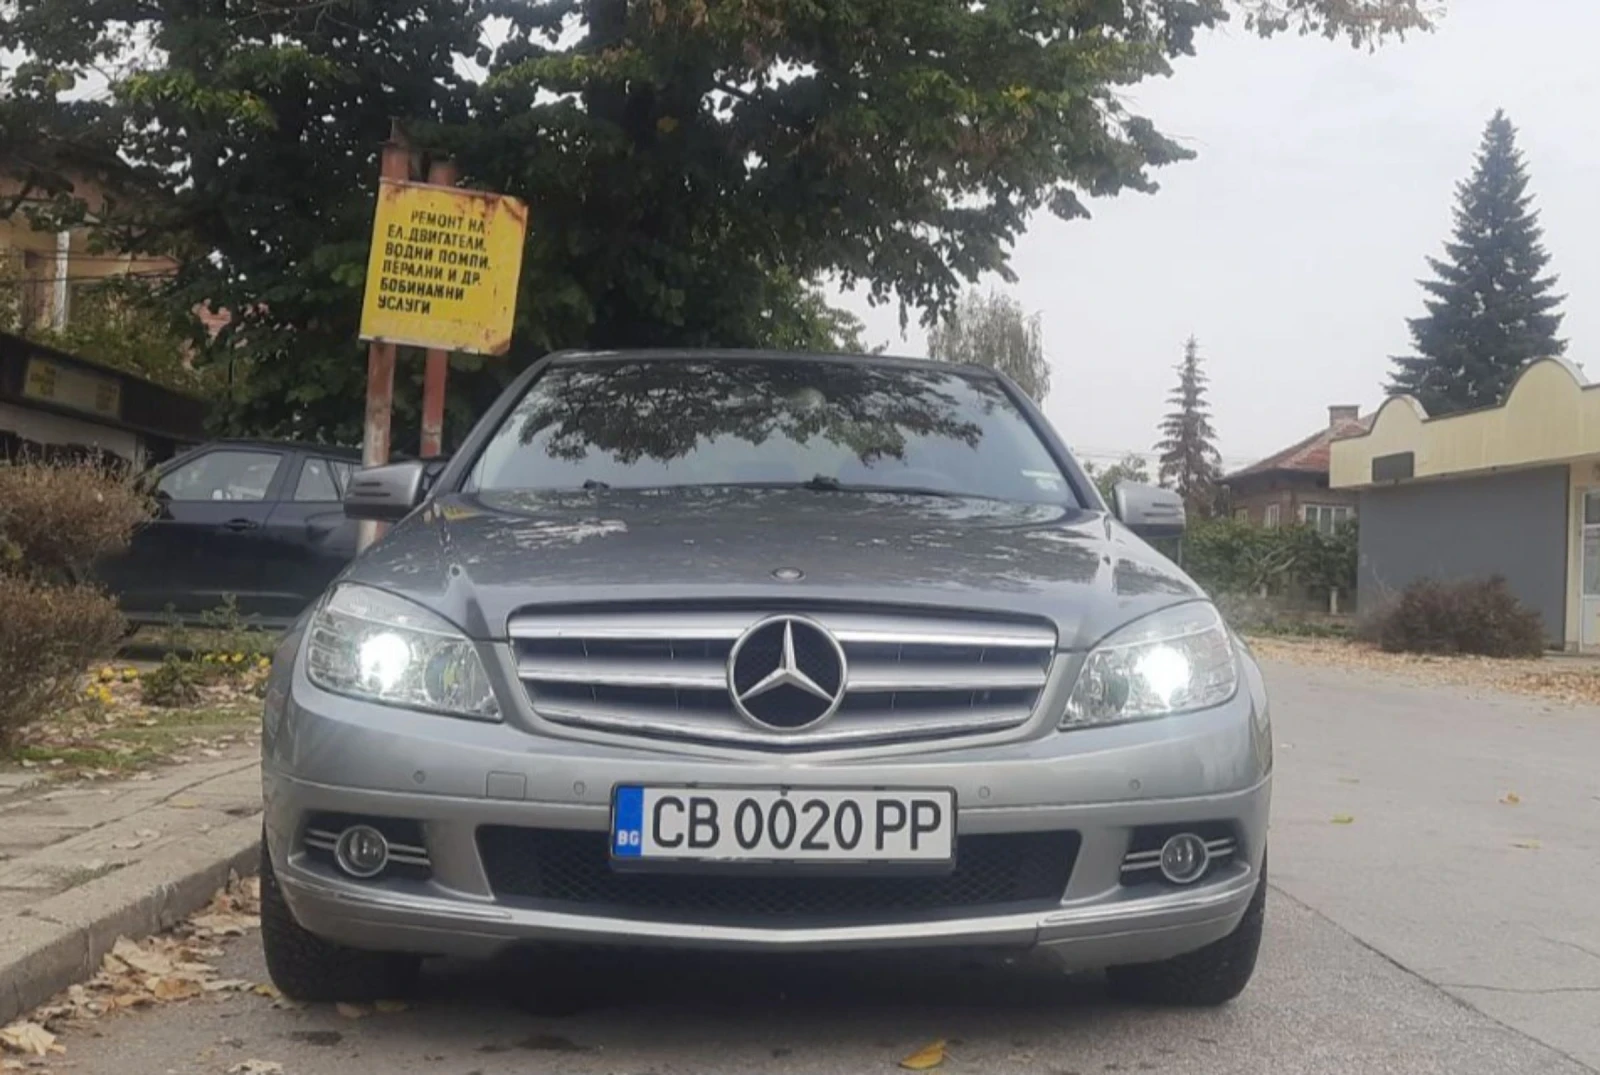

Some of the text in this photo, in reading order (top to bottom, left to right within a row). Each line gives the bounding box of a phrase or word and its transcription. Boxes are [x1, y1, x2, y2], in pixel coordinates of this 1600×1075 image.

[411, 210, 464, 229] РЕМОНТ
[385, 242, 433, 262] ВОДНИ
[382, 259, 443, 279] ПЕРАЛНИ
[379, 276, 465, 301] БОБИНАЖНИ
[377, 296, 431, 315] УСЛУГИ
[652, 796, 942, 851] CB 0020 PP
[617, 831, 640, 847] BG
